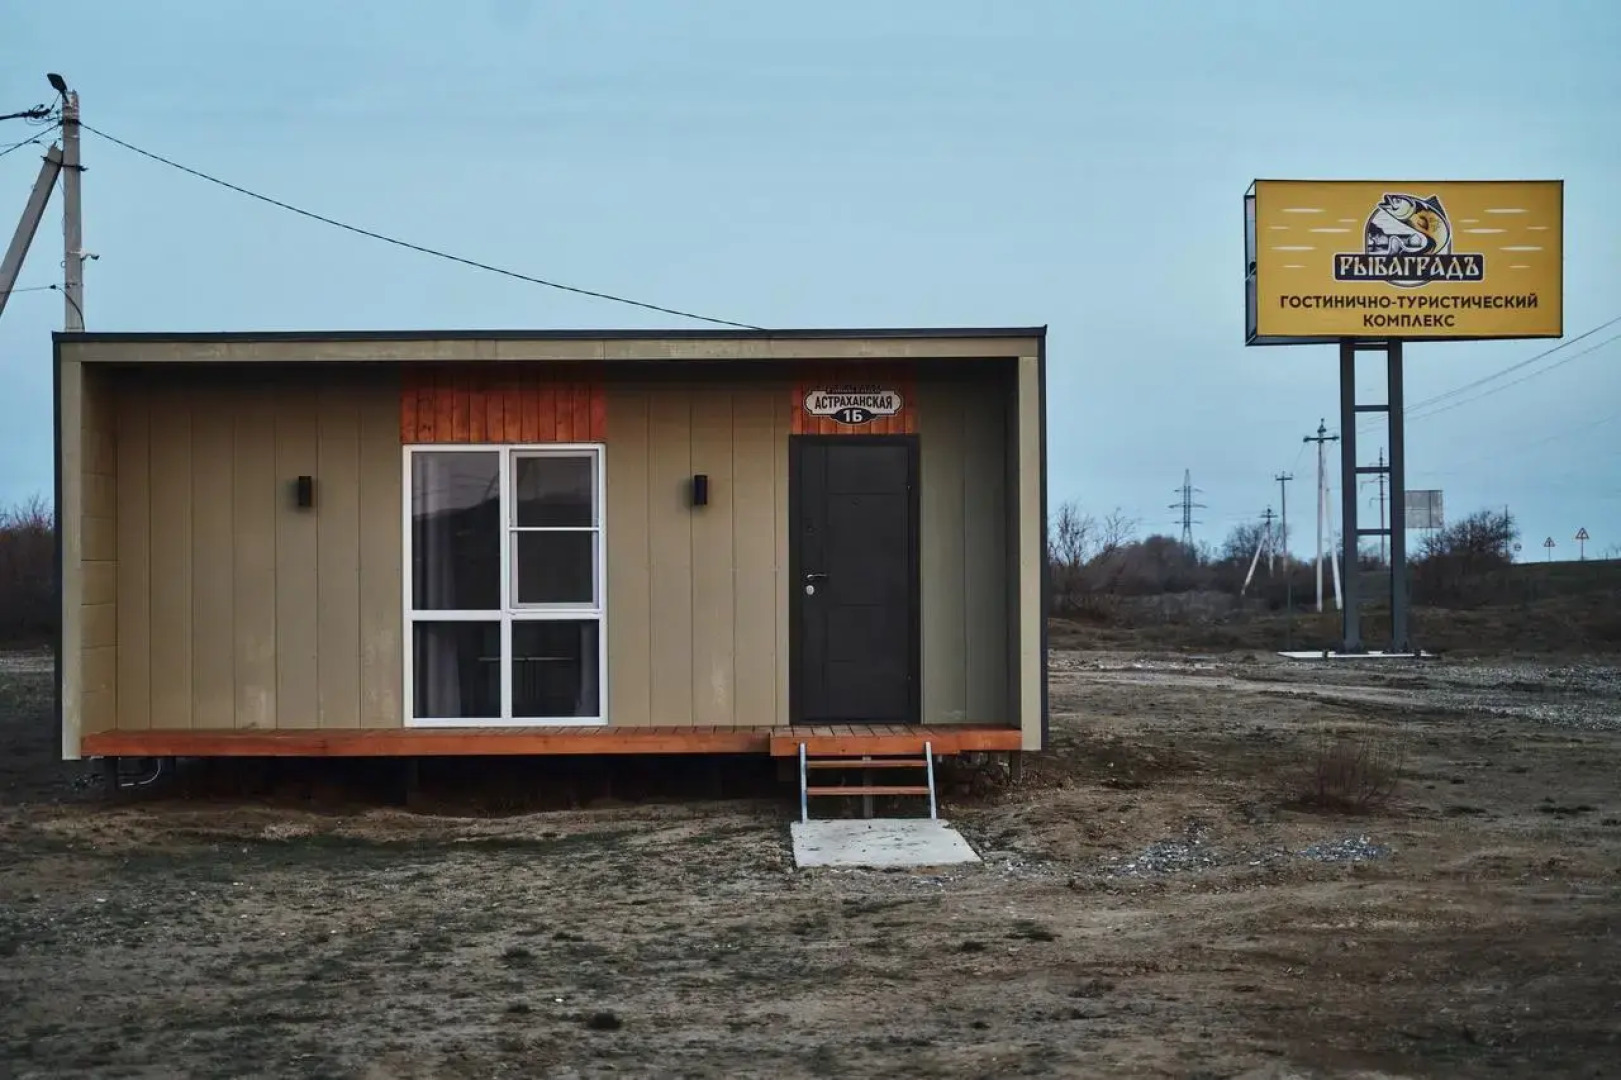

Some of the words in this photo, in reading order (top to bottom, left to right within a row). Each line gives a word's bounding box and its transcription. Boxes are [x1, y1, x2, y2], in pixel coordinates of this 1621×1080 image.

[1339, 255, 1480, 280] РЫБАГРАДЪ
[1279, 293, 1538, 309] ГОСТИНИЧНО-ТУРИСТИЧЕСКИЙ
[1363, 314, 1455, 328] КОМПЛЕКС
[815, 396, 893, 409] АСТРАХАНСКАЯ
